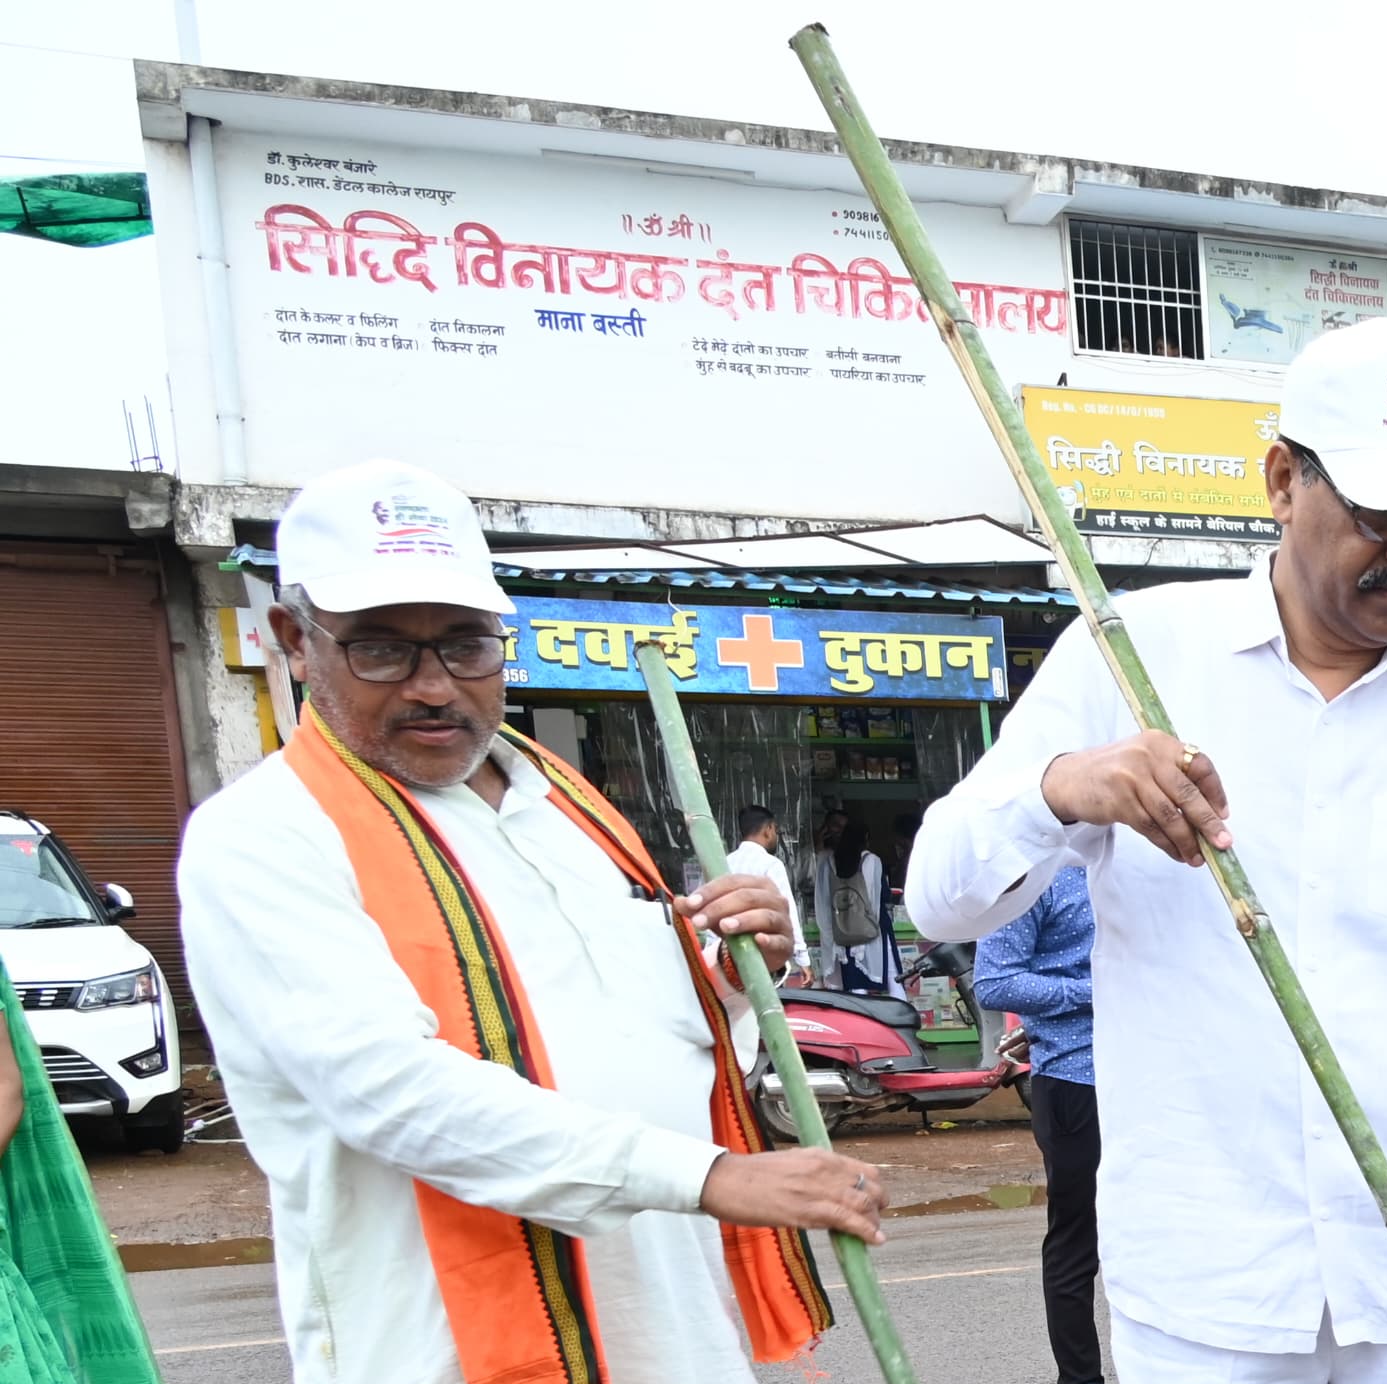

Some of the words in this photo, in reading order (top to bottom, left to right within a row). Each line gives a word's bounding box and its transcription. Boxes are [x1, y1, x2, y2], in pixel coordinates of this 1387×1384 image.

[343, 158, 378, 177] बंजारे
[264, 172, 296, 188] BDS.
[333, 175, 364, 193] डेंटल
[366, 181, 412, 198] कालेज
[414, 187, 457, 206] रायपुर
[667, 213, 694, 240] श्री
[444, 221, 689, 303] विनायक
[695, 248, 783, 322] दंत
[300, 307, 313, 323] के
[533, 308, 587, 333] माना
[590, 307, 648, 338] बस्ती
[453, 318, 506, 337] निकालना
[306, 331, 348, 347] लगाना
[757, 345, 773, 356] का
[775, 346, 809, 358] उपचार
[756, 364, 771, 376] का
[773, 365, 811, 378] उपचार
[829, 366, 873, 382] पायरिया
[874, 371, 891, 383] का
[892, 372, 927, 387] उपचार
[1132, 440, 1248, 480] विनायक
[1095, 510, 1117, 528] हाई
[1119, 514, 1151, 532] स्कूल
[1154, 513, 1168, 529] के
[1170, 515, 1203, 533] सामने
[530, 611, 700, 681] दवाई
[819, 631, 994, 694] दुकान
